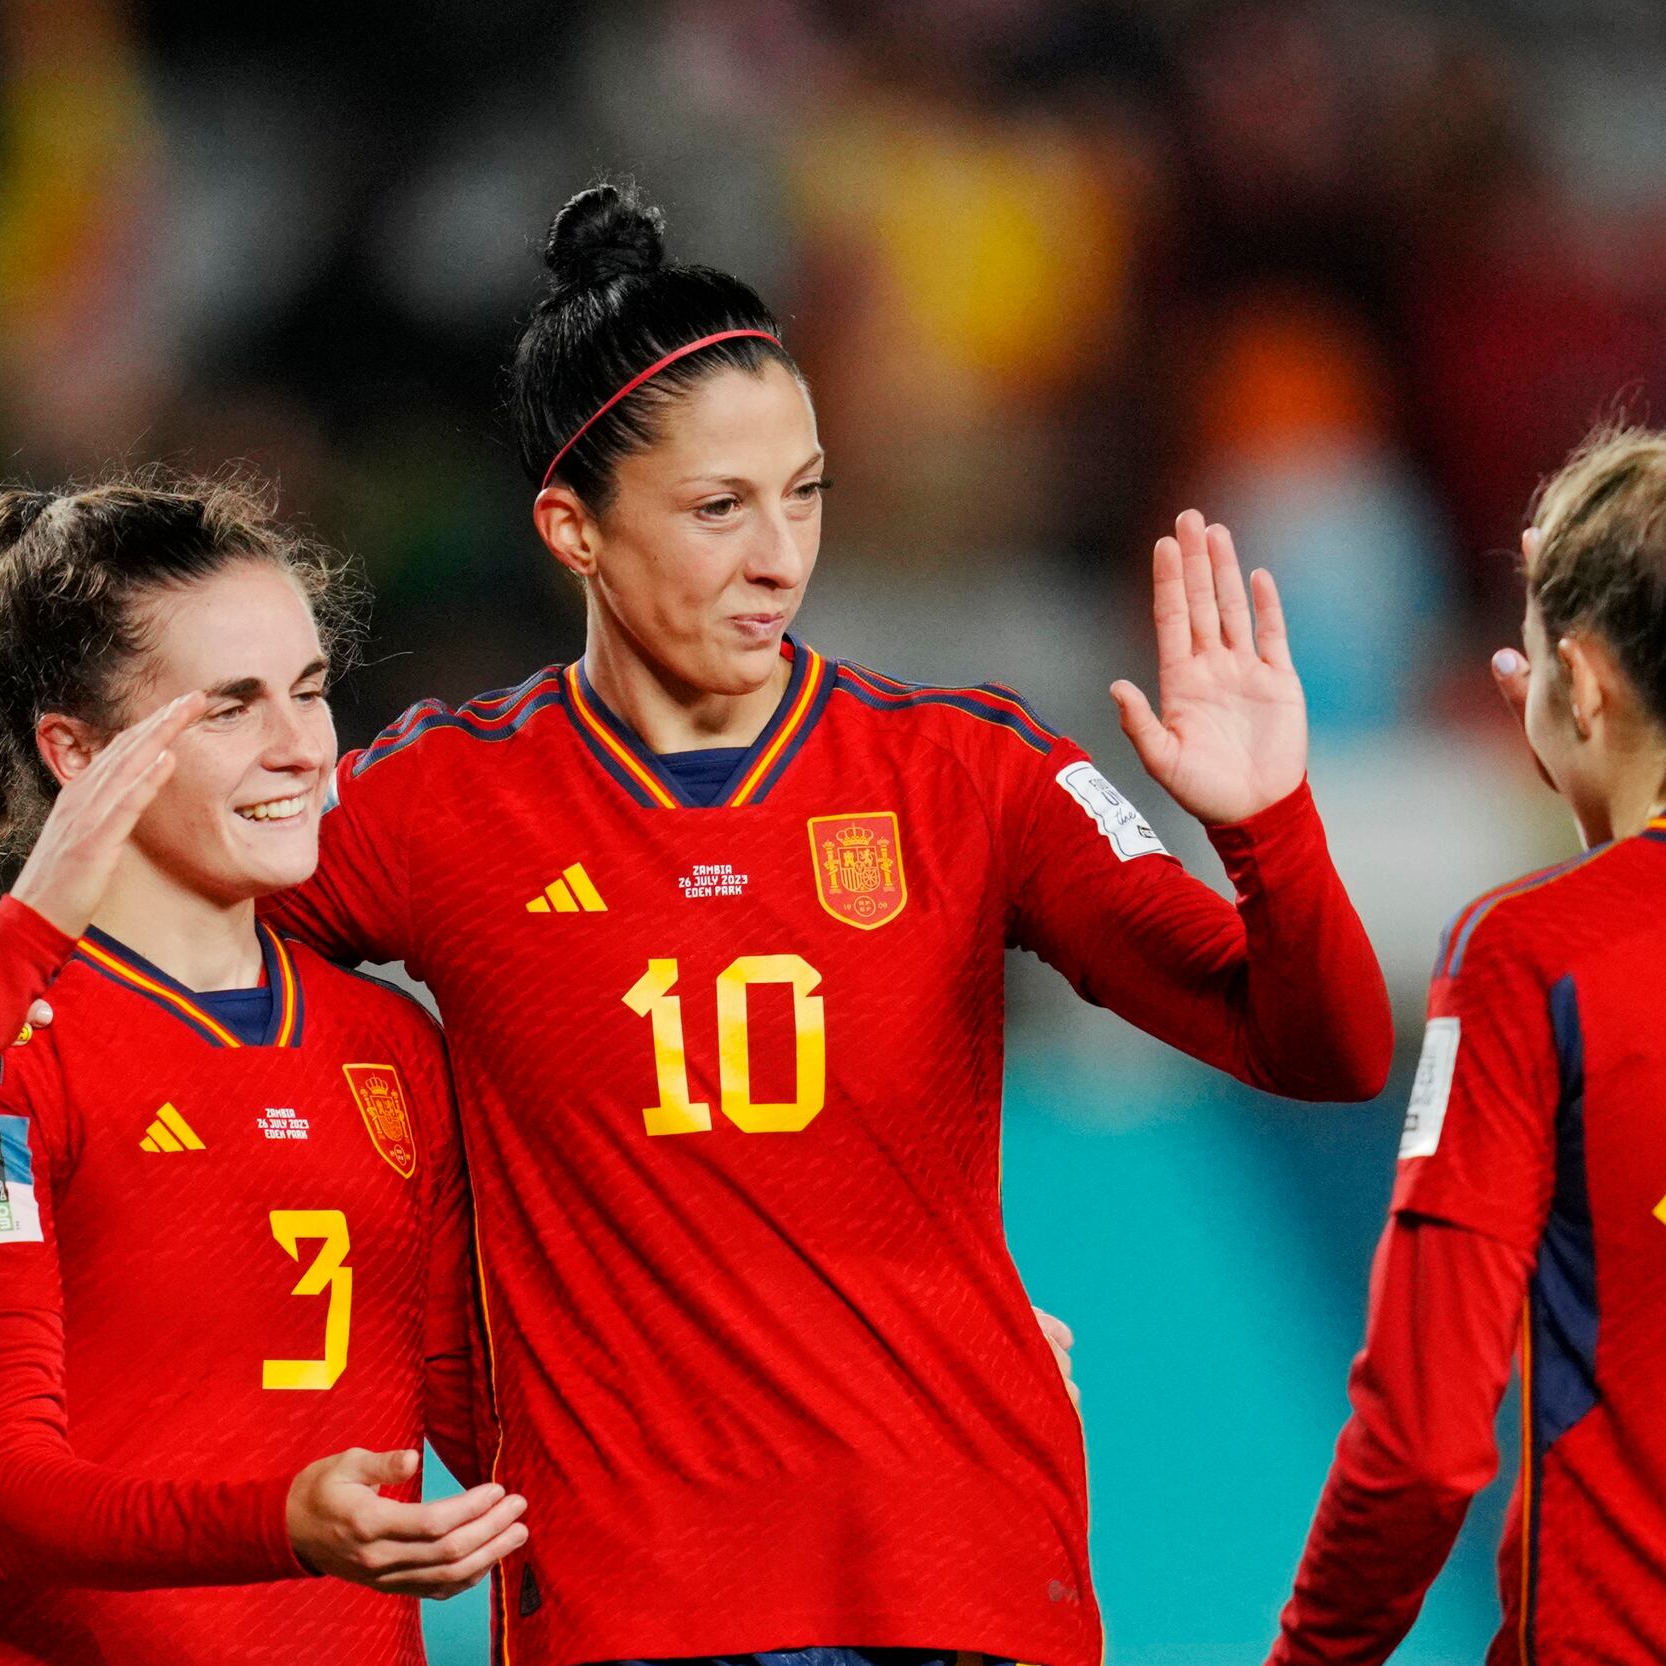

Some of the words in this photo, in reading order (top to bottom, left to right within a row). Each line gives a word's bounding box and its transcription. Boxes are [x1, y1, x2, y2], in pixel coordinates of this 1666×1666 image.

[693, 865, 732, 875] ZAMBIA
[678, 877, 691, 888] 26
[694, 876, 718, 886] JULY
[721, 874, 748, 885] 2023
[685, 887, 712, 898] EDEN
[715, 886, 742, 896] PARK
[621, 953, 826, 1137] 10
[265, 1107, 296, 1118] ZAMBIA
[257, 1118, 269, 1129] 26
[269, 1119, 287, 1129] JULY
[288, 1119, 310, 1129] 2023
[264, 1129, 286, 1139] EDEN
[262, 1209, 353, 1390] 3
